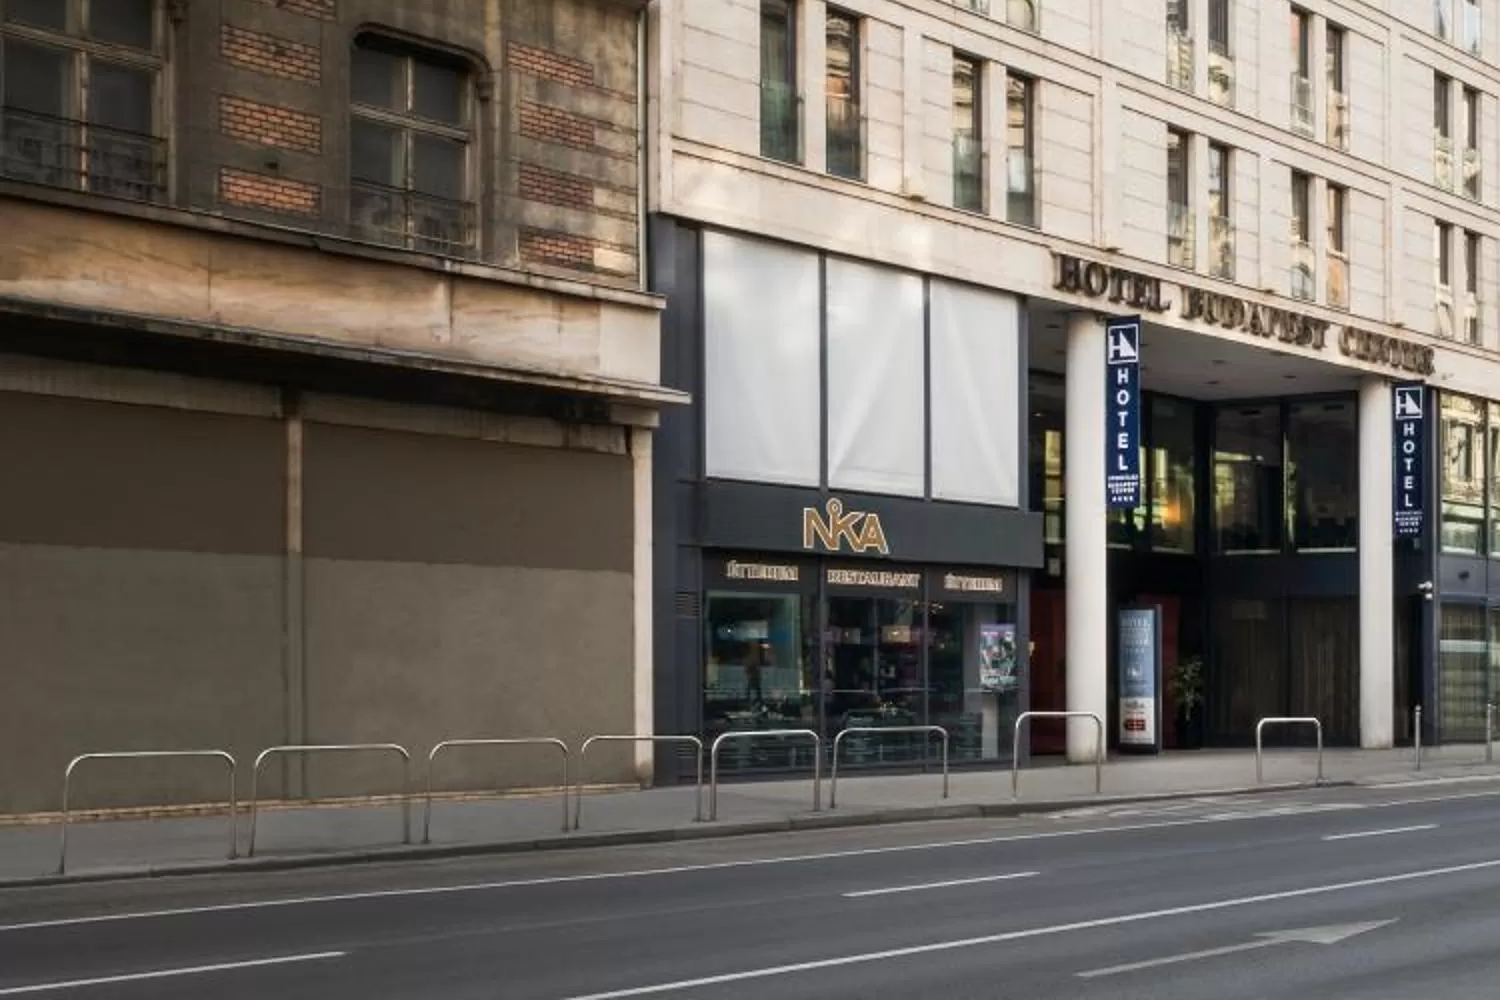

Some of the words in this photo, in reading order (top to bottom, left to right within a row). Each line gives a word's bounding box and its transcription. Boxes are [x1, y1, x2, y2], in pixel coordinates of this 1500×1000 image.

[1052, 253, 1171, 314] HOTEL
[1116, 367, 1130, 471] HOTEL
[1403, 422, 1415, 507] HOTEL
[827, 569, 920, 589] RESTAURANT
